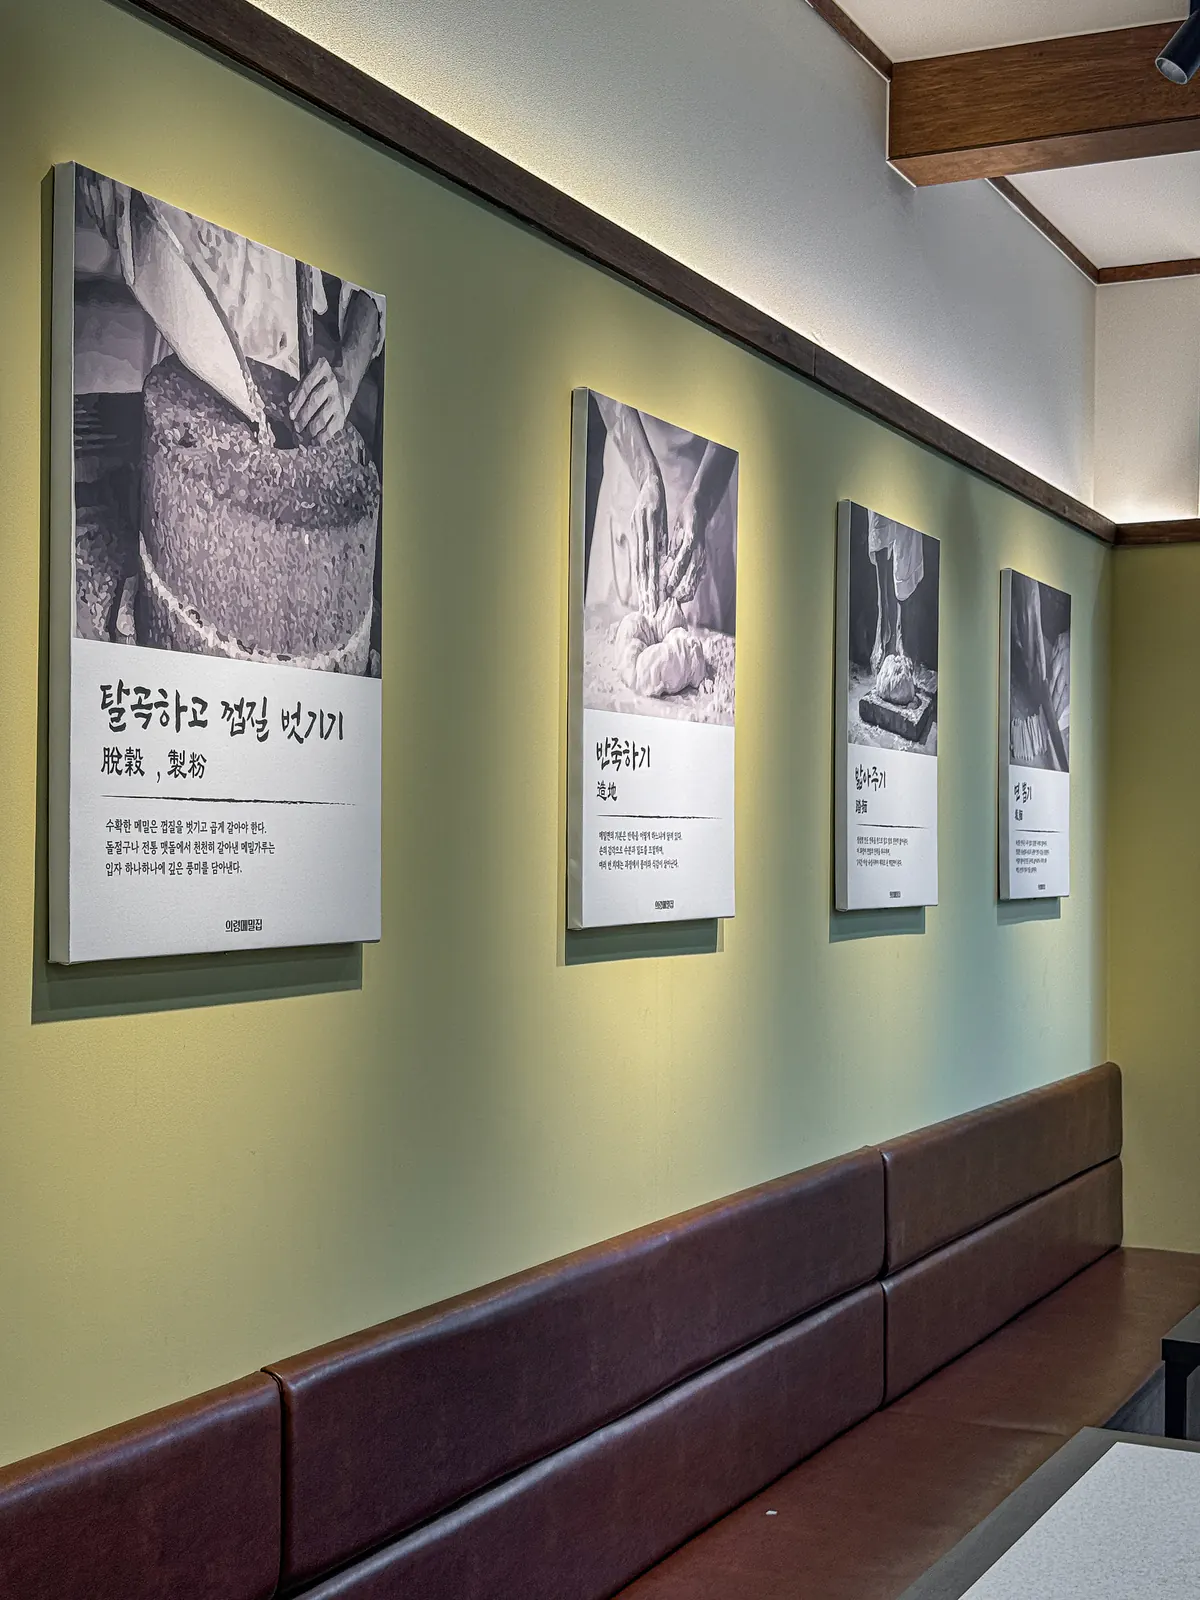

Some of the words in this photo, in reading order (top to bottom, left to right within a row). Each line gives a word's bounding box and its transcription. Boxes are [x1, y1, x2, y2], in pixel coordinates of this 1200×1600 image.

[100, 679, 208, 733] 탈곡하고
[221, 696, 269, 742] 껍질
[282, 701, 343, 744] 벗기기
[597, 737, 650, 771] 반죽하기
[101, 747, 145, 776] 脫穀
[167, 749, 207, 779] 製粉
[106, 819, 131, 833] 수확한
[134, 820, 158, 833] 메밀은
[161, 820, 183, 834] 껍질을
[186, 820, 207, 834] 벗기고
[210, 821, 224, 834] 곱게
[227, 821, 248, 834] 갈아야
[251, 822, 266, 834] 한다.
[106, 841, 139, 854] 돌절구나
[142, 841, 158, 855] 전통
[194, 841, 214, 854] 천천히
[217, 841, 238, 854] 갈아낸
[241, 841, 275, 854] 메밀가루는
[106, 862, 122, 876] 입자
[125, 862, 165, 875] 하나하나에
[169, 862, 183, 875] 깊은
[186, 861, 208, 875] 풍미를
[212, 861, 242, 874] 담아낸다.
[226, 919, 262, 932] 의령메밀집
